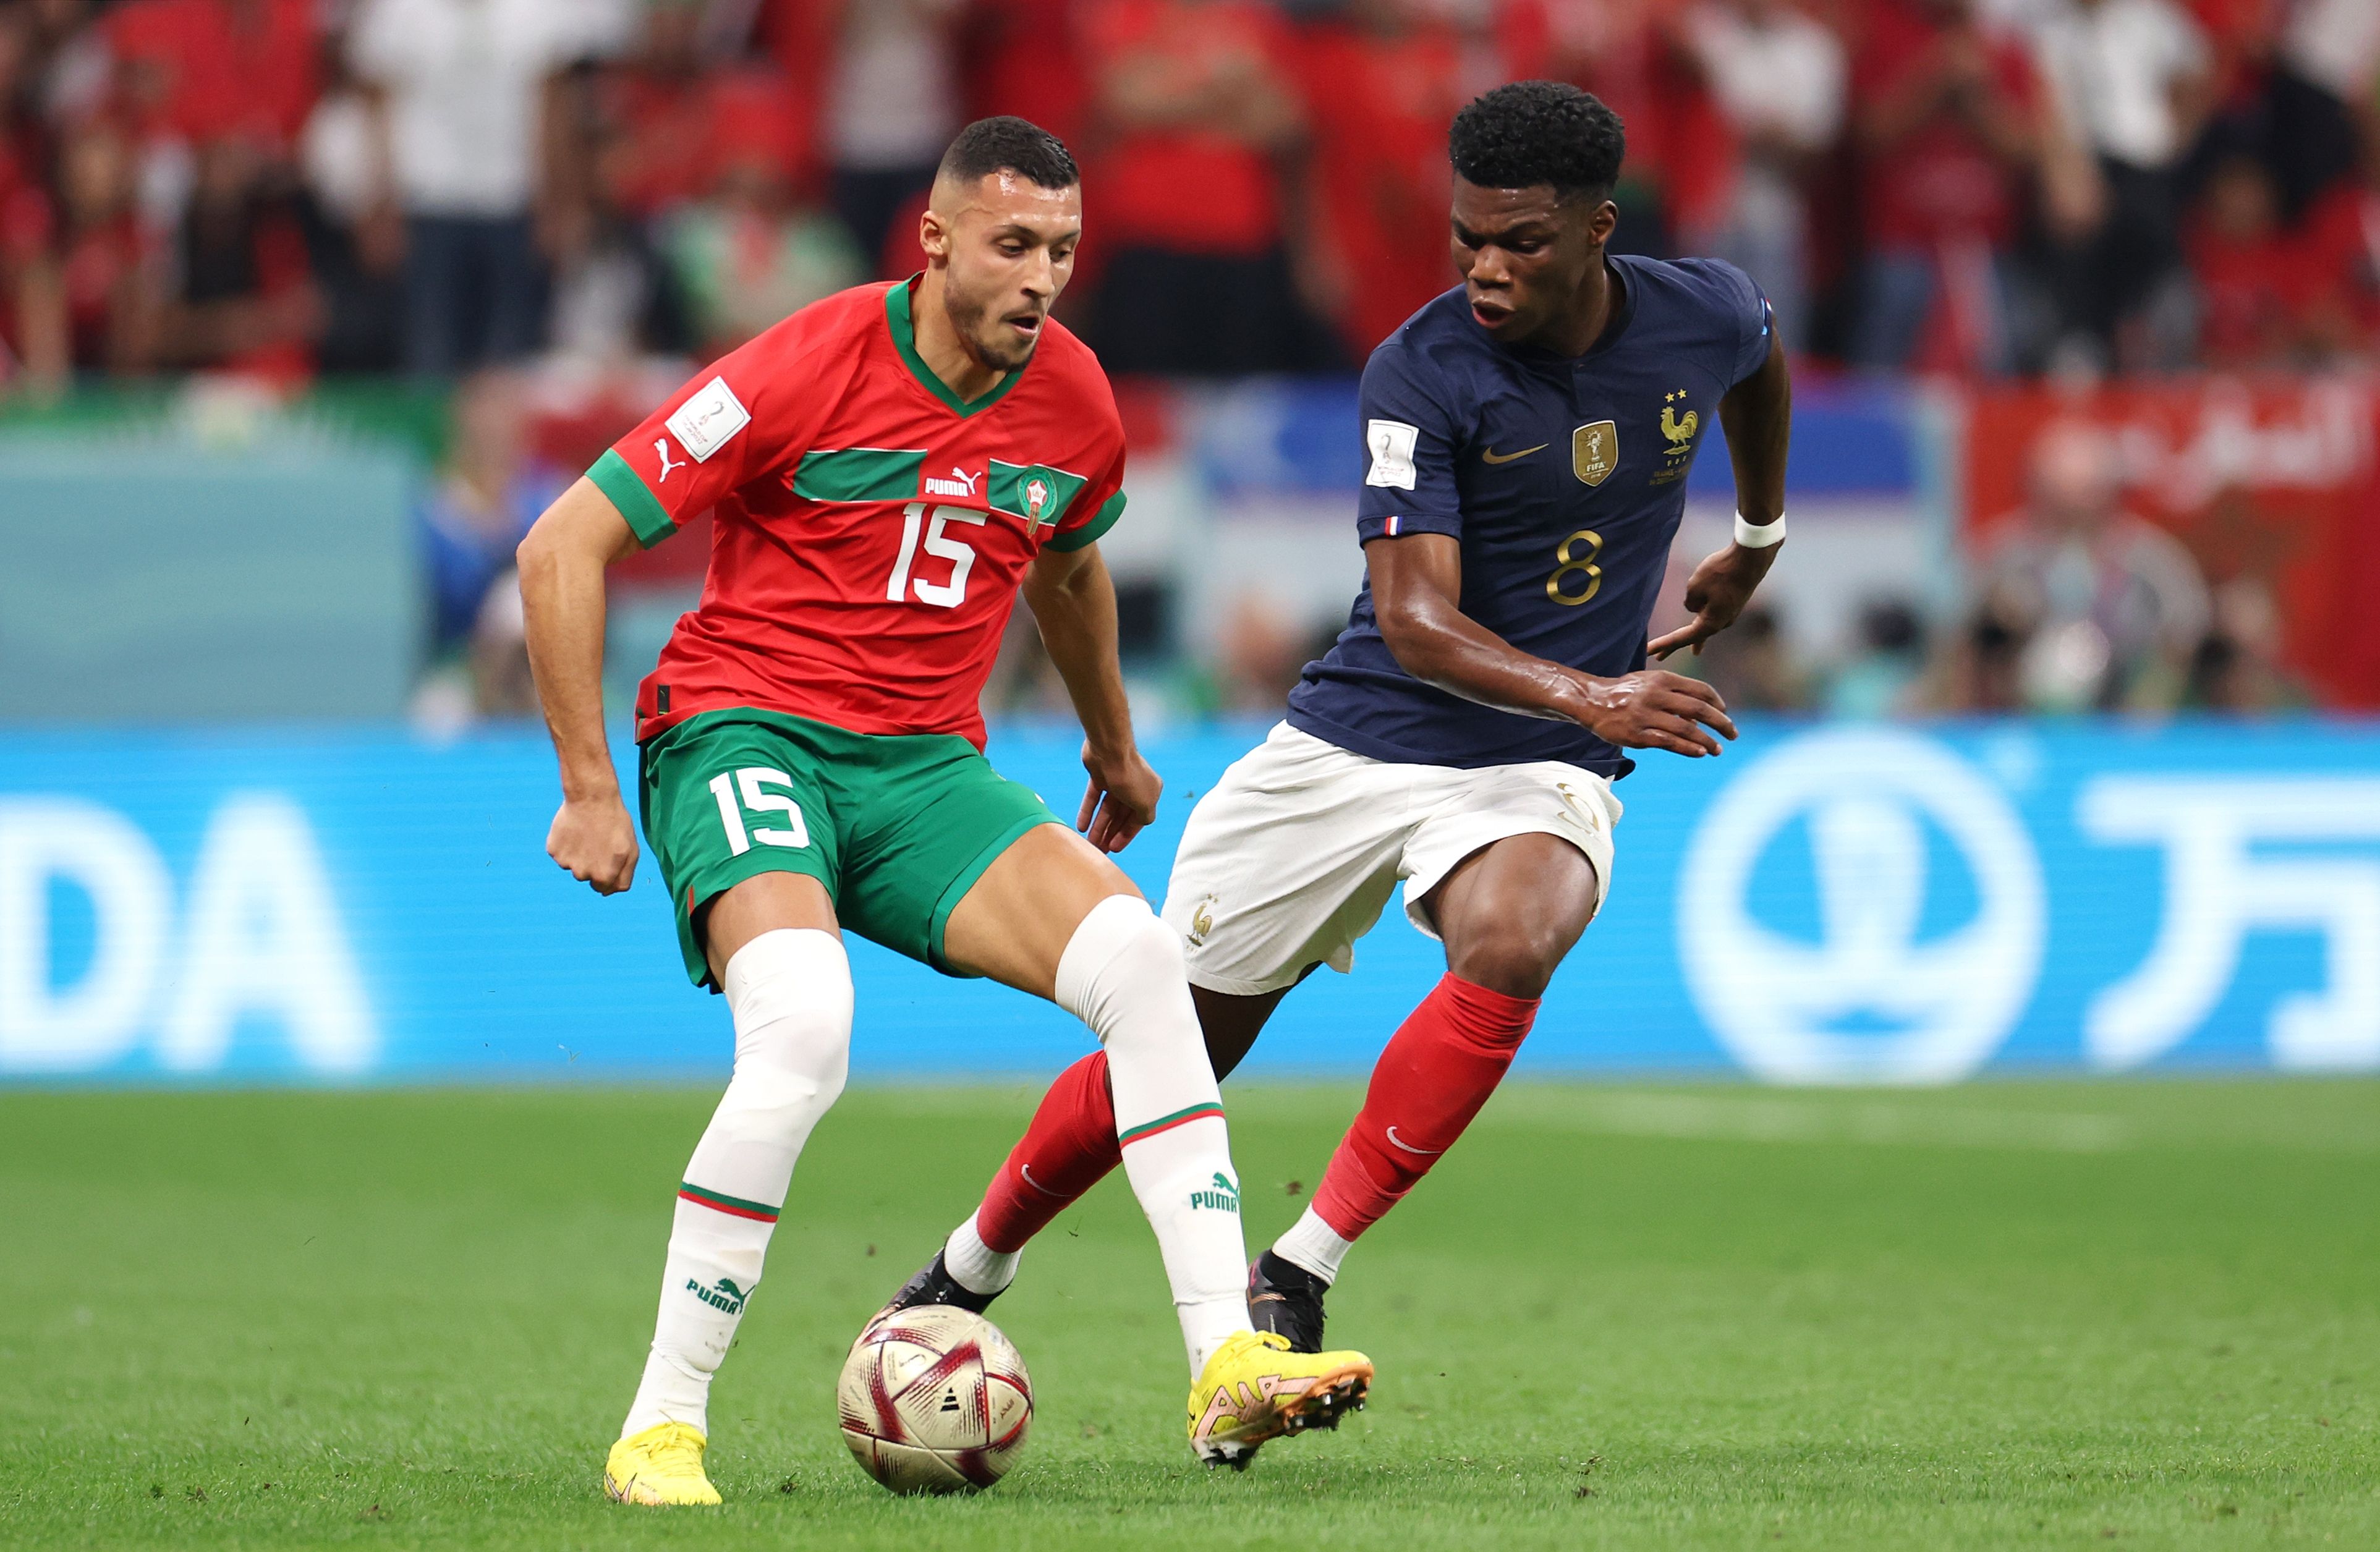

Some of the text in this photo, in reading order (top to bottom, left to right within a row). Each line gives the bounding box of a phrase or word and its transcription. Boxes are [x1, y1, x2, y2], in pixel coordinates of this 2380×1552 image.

[1586, 462, 1605, 472] FIFA
[925, 478, 969, 497] PUMA
[886, 502, 989, 608] 15
[1546, 530, 1604, 606] 8
[708, 767, 810, 857] 15
[1191, 1191, 1237, 1213] PUMA
[686, 1278, 739, 1315] PUMA
